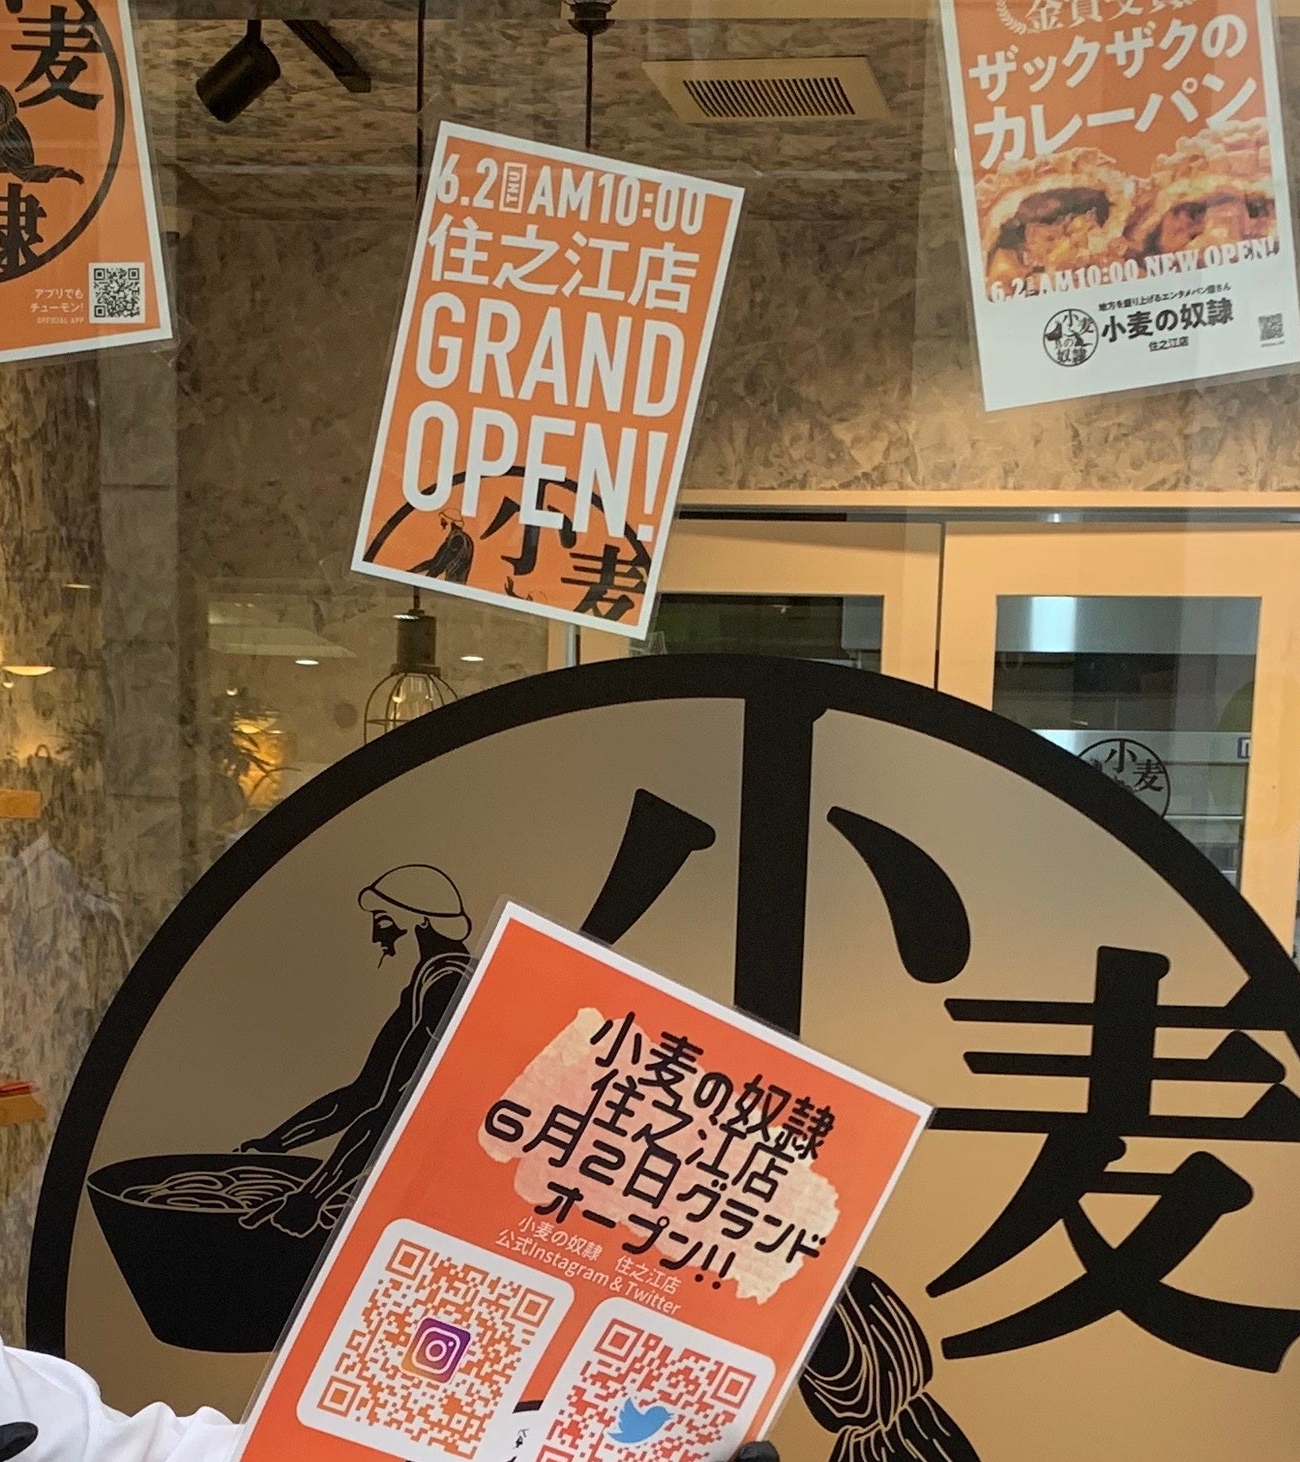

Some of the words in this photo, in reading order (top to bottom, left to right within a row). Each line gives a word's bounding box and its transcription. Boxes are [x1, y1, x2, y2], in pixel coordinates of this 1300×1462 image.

[968, 14, 1248, 102] ザックザクの
[974, 74, 1257, 169] カレーパン
[438, 153, 498, 210] 6.2
[528, 167, 704, 235] AM10:00
[35, 289, 84, 299] アプリでも
[428, 214, 699, 313] 住之江店
[1145, 251, 1201, 280] NEW
[1204, 237, 1280, 267] OPEN!
[31, 303, 84, 312] チューモン!
[1101, 297, 1234, 344] 小麦の奴隷
[1149, 336, 1189, 351] 住之江店
[415, 293, 684, 417] GRAND
[402, 401, 668, 542] OPEN!
[590, 1012, 837, 1160] 小麦の奴隷
[592, 1069, 794, 1202] 住之江店
[484, 1100, 826, 1264] 6月2日グランド
[518, 1216, 603, 1262] 小麦の奴隷
[615, 1255, 681, 1294] 住之江店
[625, 1281, 681, 1315] Twitter
